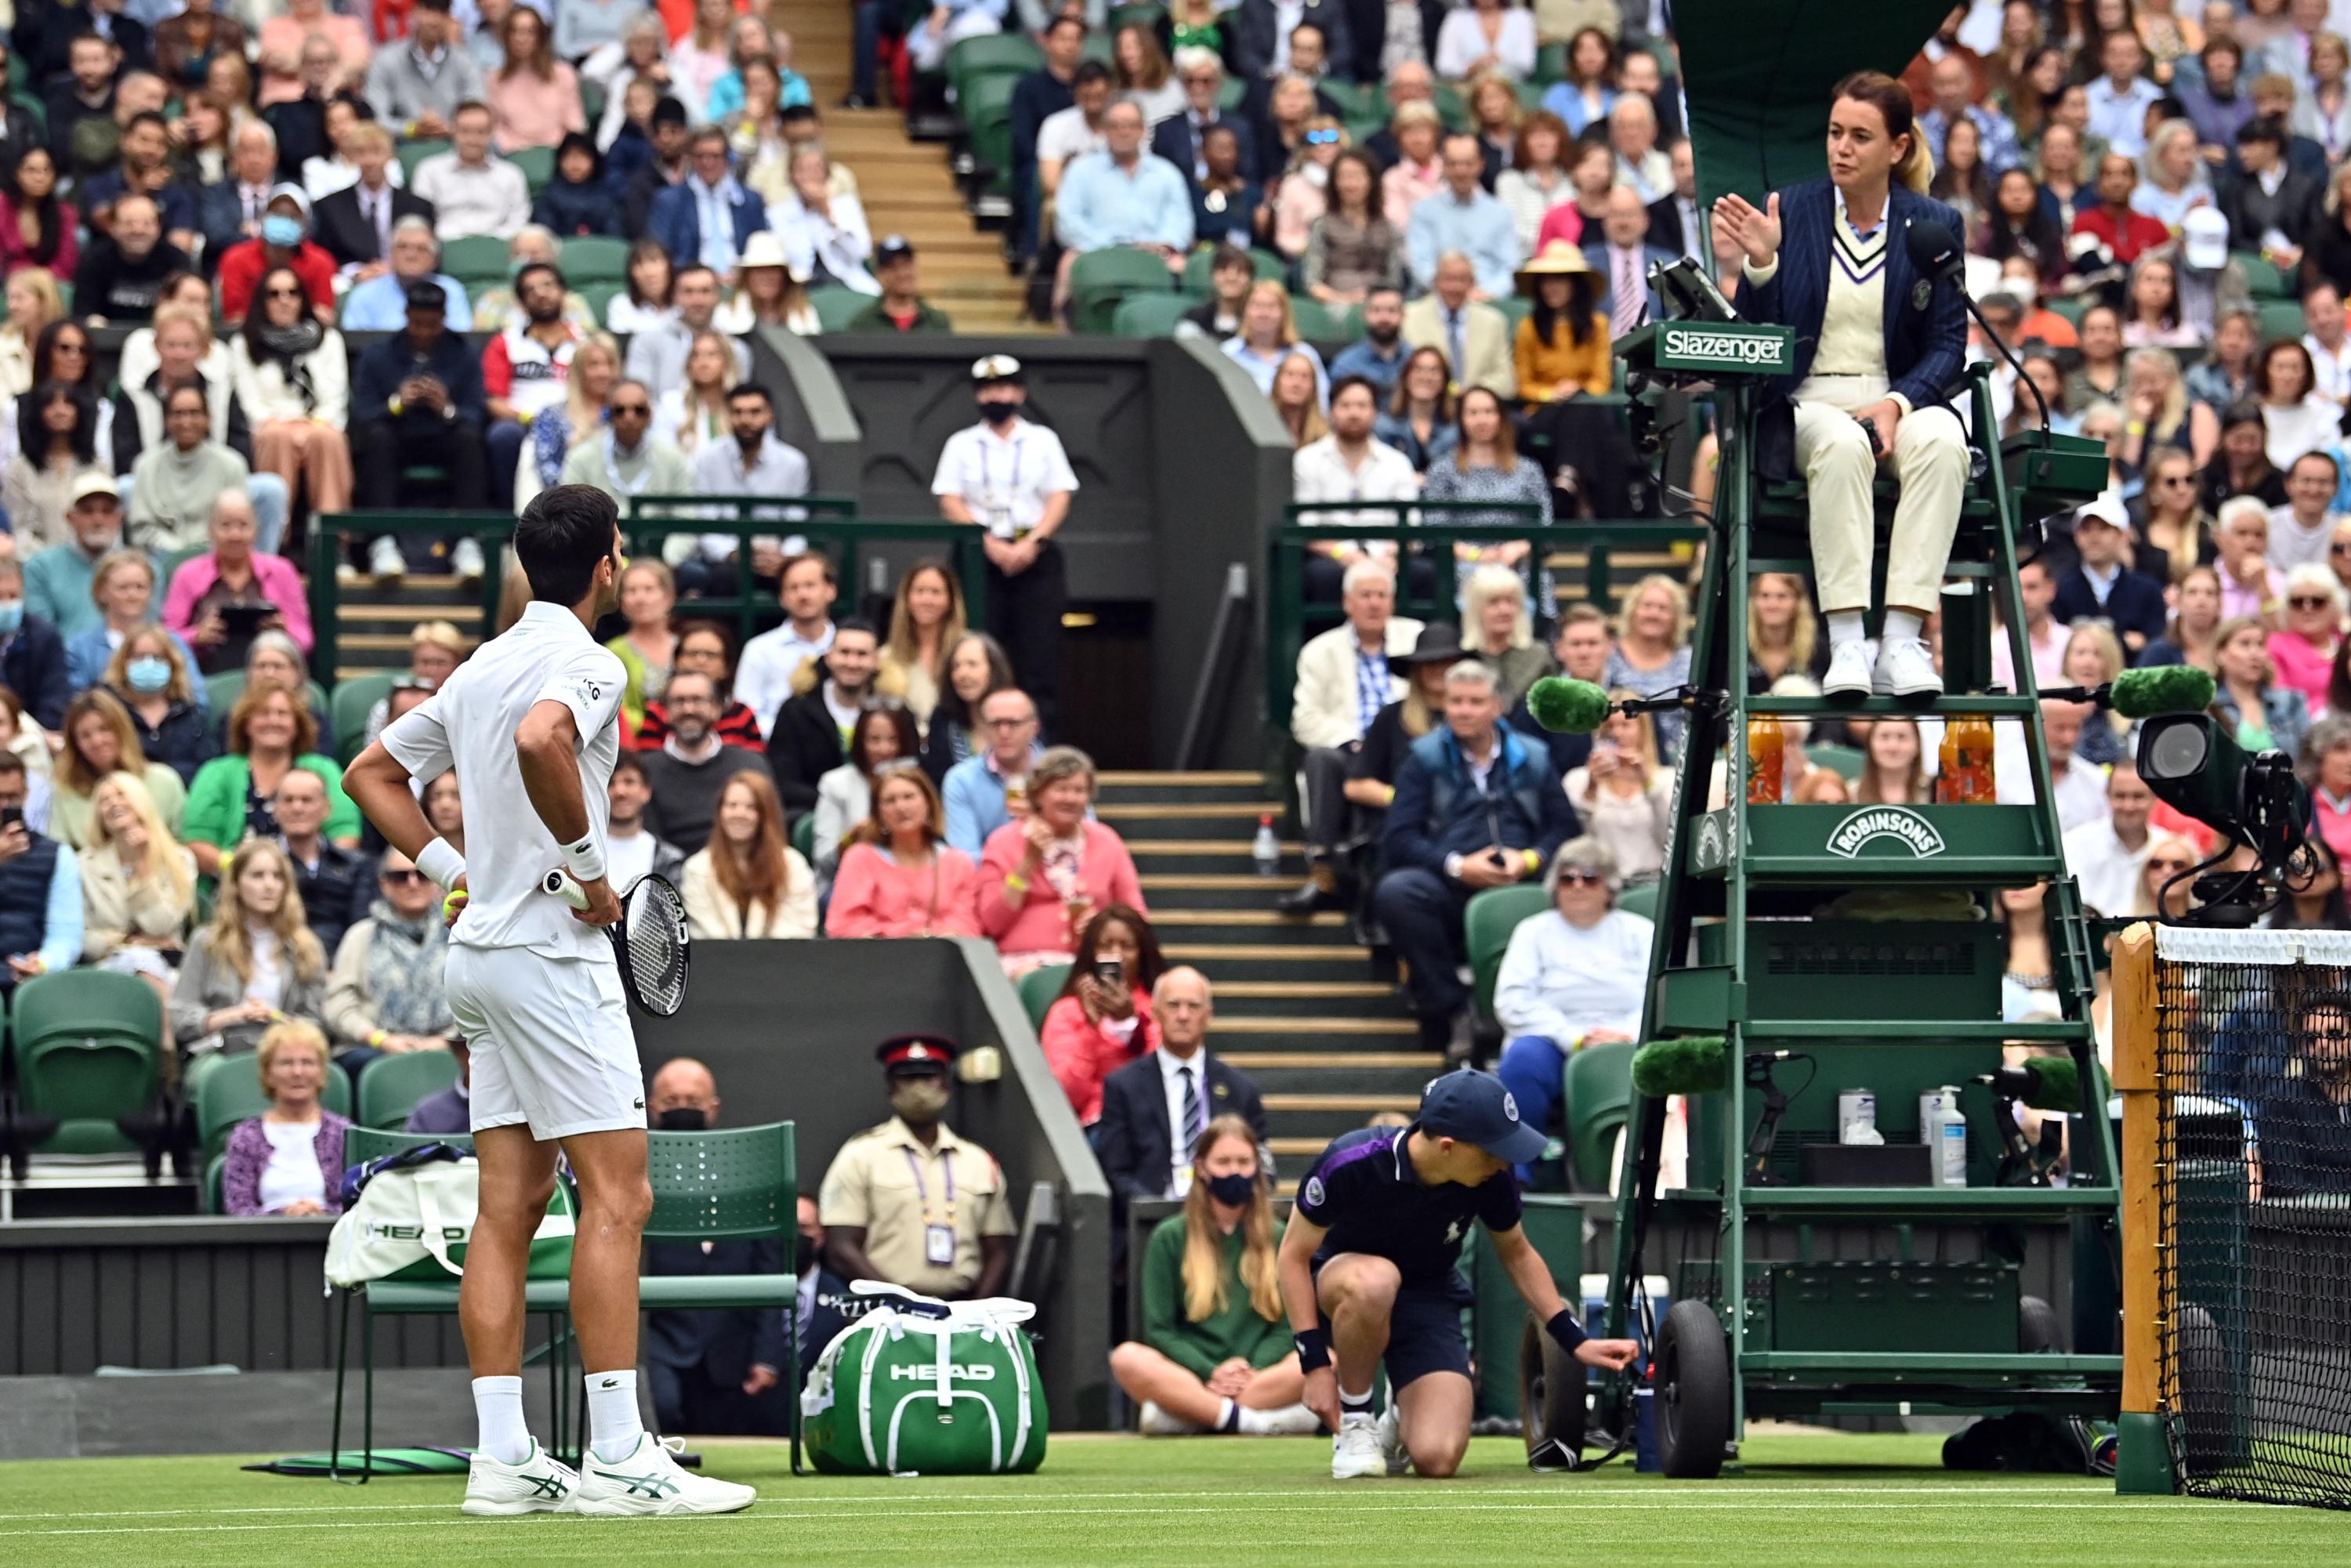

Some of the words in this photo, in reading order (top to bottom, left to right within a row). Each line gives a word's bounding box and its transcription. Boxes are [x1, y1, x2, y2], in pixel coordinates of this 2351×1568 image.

[1665, 330, 1784, 364] Slazenger
[1836, 812, 1935, 852] ROBINSONS
[367, 1225, 465, 1239] HED
[890, 1363, 995, 1381] HEAD
